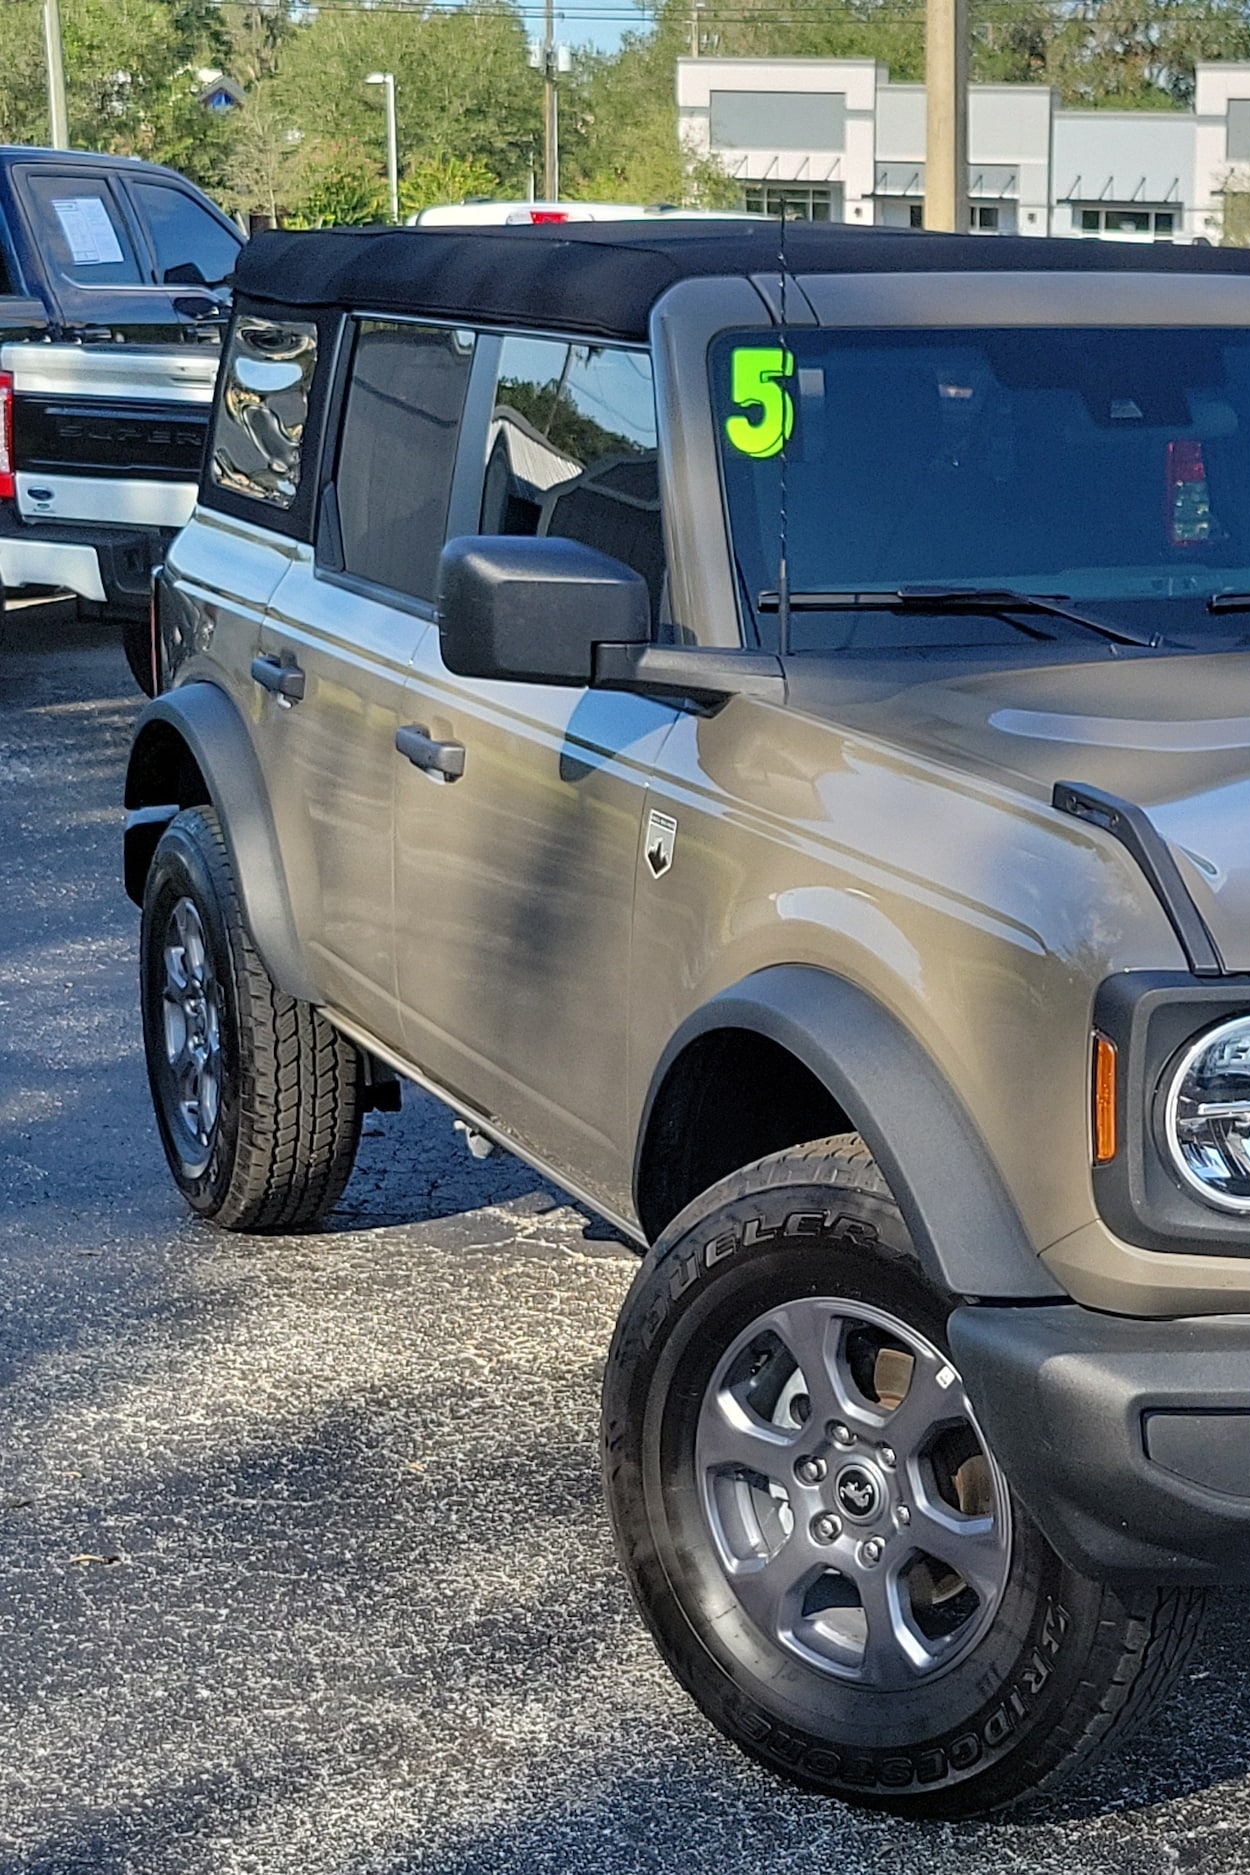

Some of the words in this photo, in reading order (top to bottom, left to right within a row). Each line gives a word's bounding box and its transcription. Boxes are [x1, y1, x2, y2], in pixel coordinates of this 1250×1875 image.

[58, 424, 203, 446] SUPER
[726, 347, 794, 458] 5
[640, 1209, 881, 1350] DUELER
[736, 1596, 1070, 1788] BRIDGESTONE
